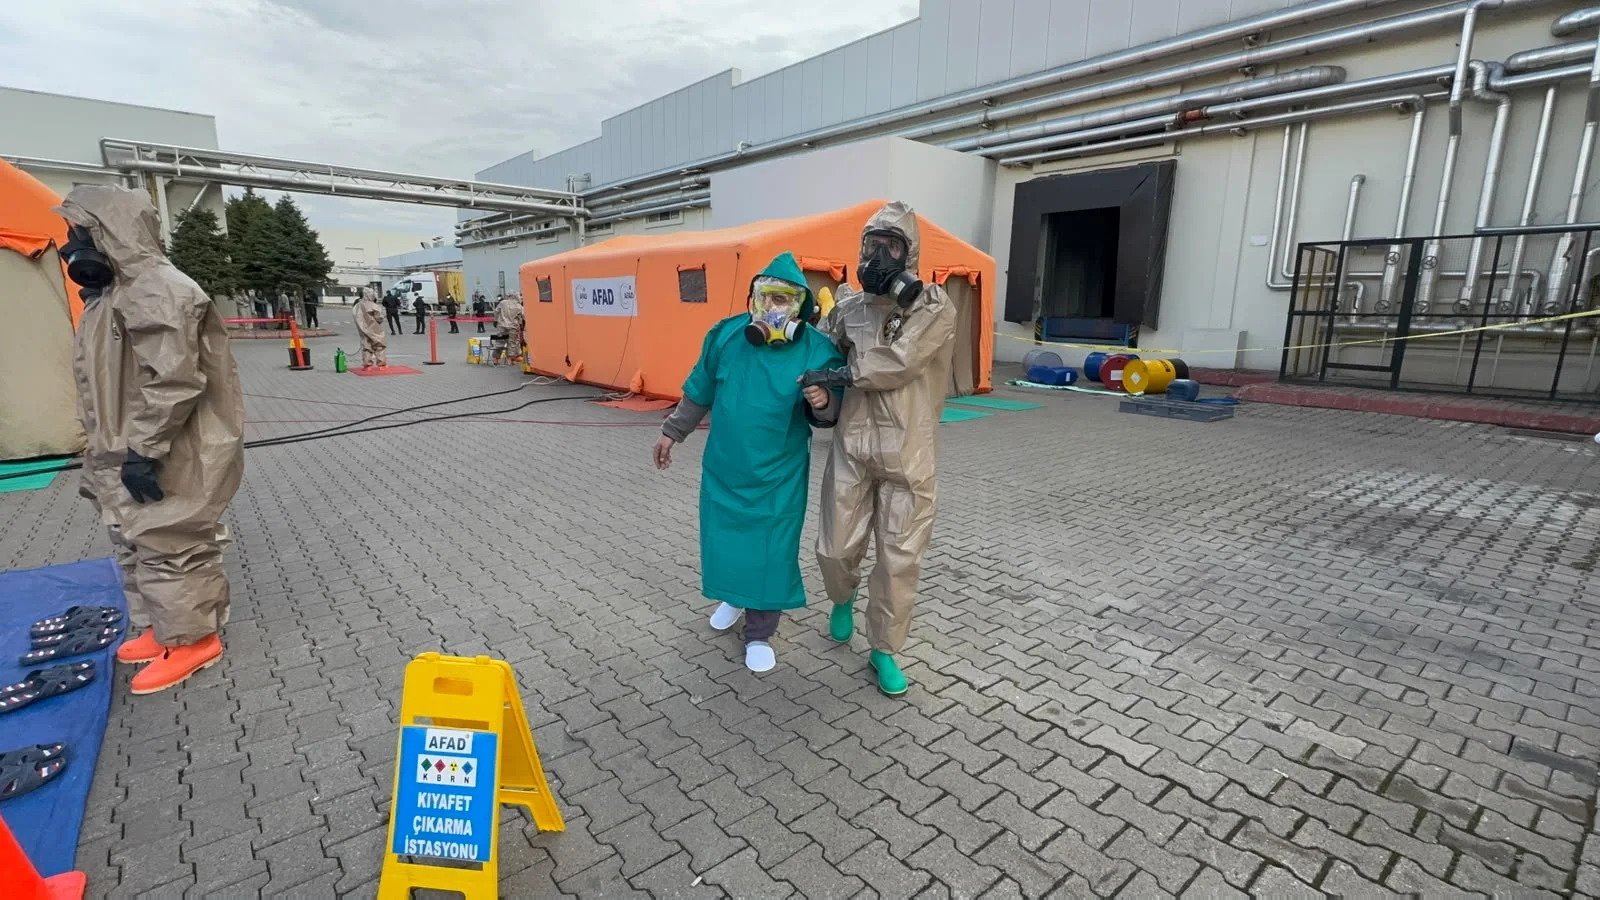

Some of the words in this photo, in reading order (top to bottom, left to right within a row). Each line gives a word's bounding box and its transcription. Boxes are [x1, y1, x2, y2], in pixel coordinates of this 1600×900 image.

[592, 289, 614, 305] AFAD
[428, 736, 466, 751] AFAD
[450, 775, 455, 783] R
[417, 792, 473, 811] KIYAFET
[413, 815, 473, 836] ÇIKARMA
[404, 835, 478, 860] İSTASYONU
